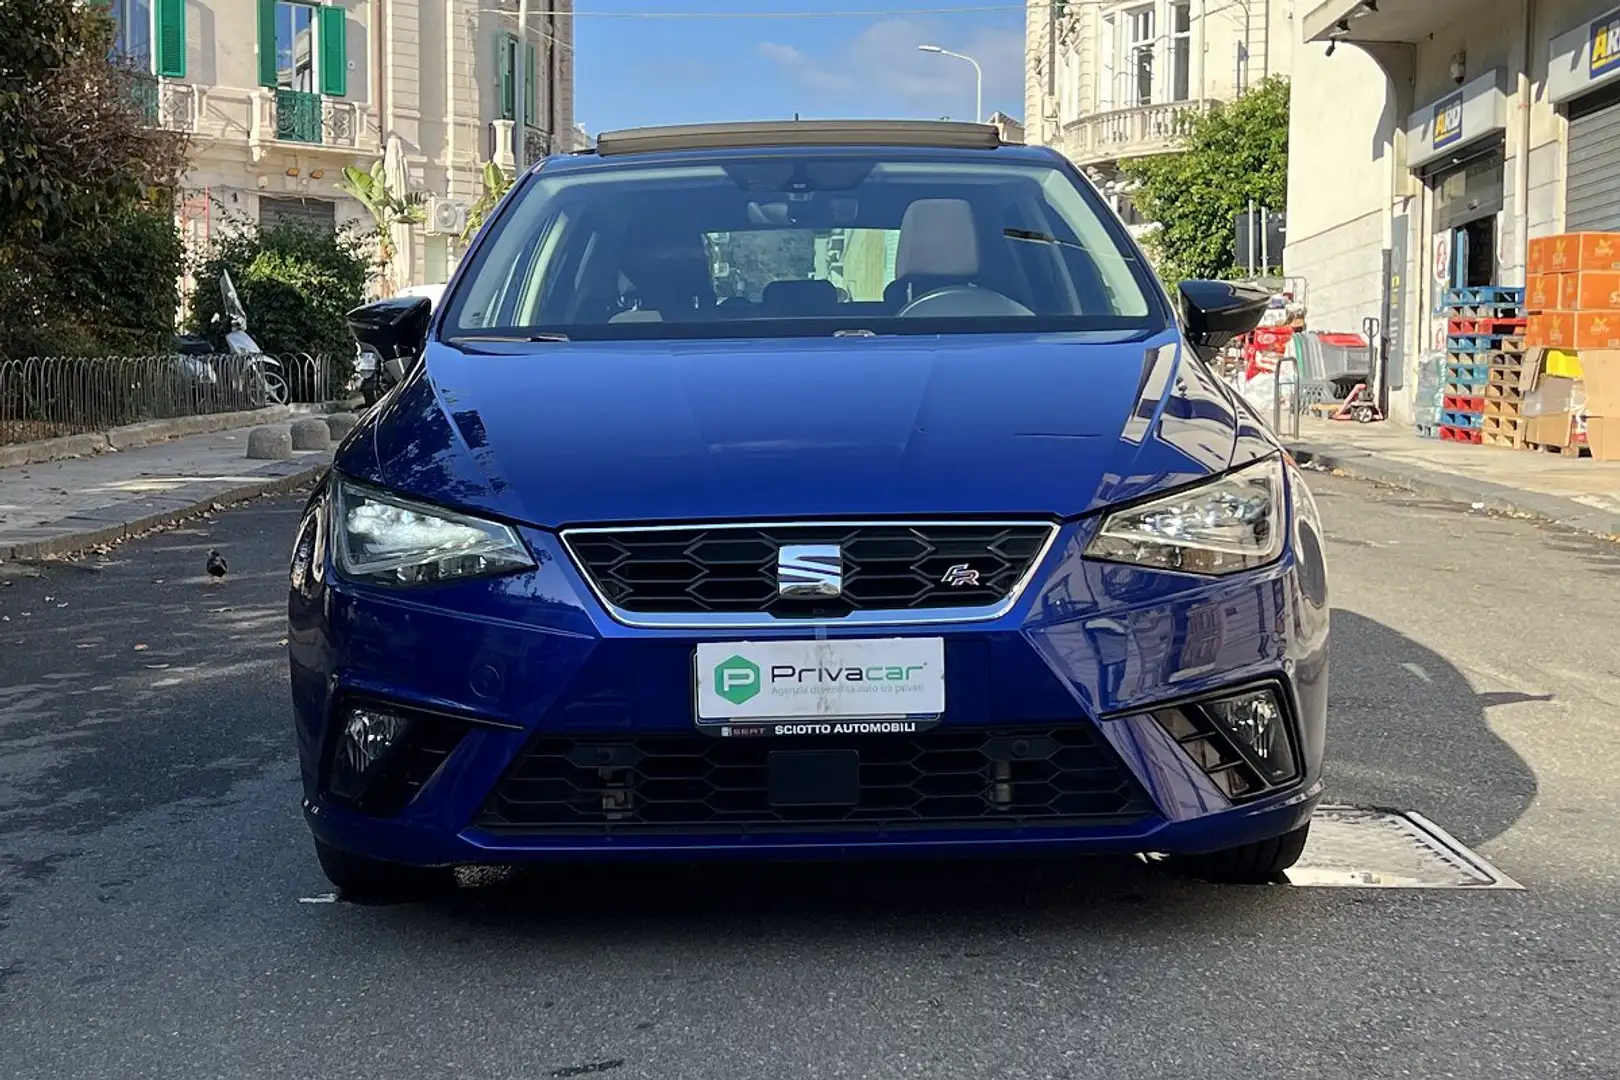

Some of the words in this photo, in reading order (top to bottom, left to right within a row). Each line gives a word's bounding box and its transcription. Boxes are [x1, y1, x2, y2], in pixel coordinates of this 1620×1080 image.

[1591, 19, 1620, 63] AR
[1435, 100, 1462, 137] ARD
[941, 563, 980, 586] FR
[771, 664, 923, 683] Privacar
[771, 685, 808, 696] Agenzia
[881, 684, 893, 693] tra
[895, 683, 924, 694] privati
[774, 723, 831, 735] SCIOTTO
[833, 722, 916, 733] AUTOMOBILI
